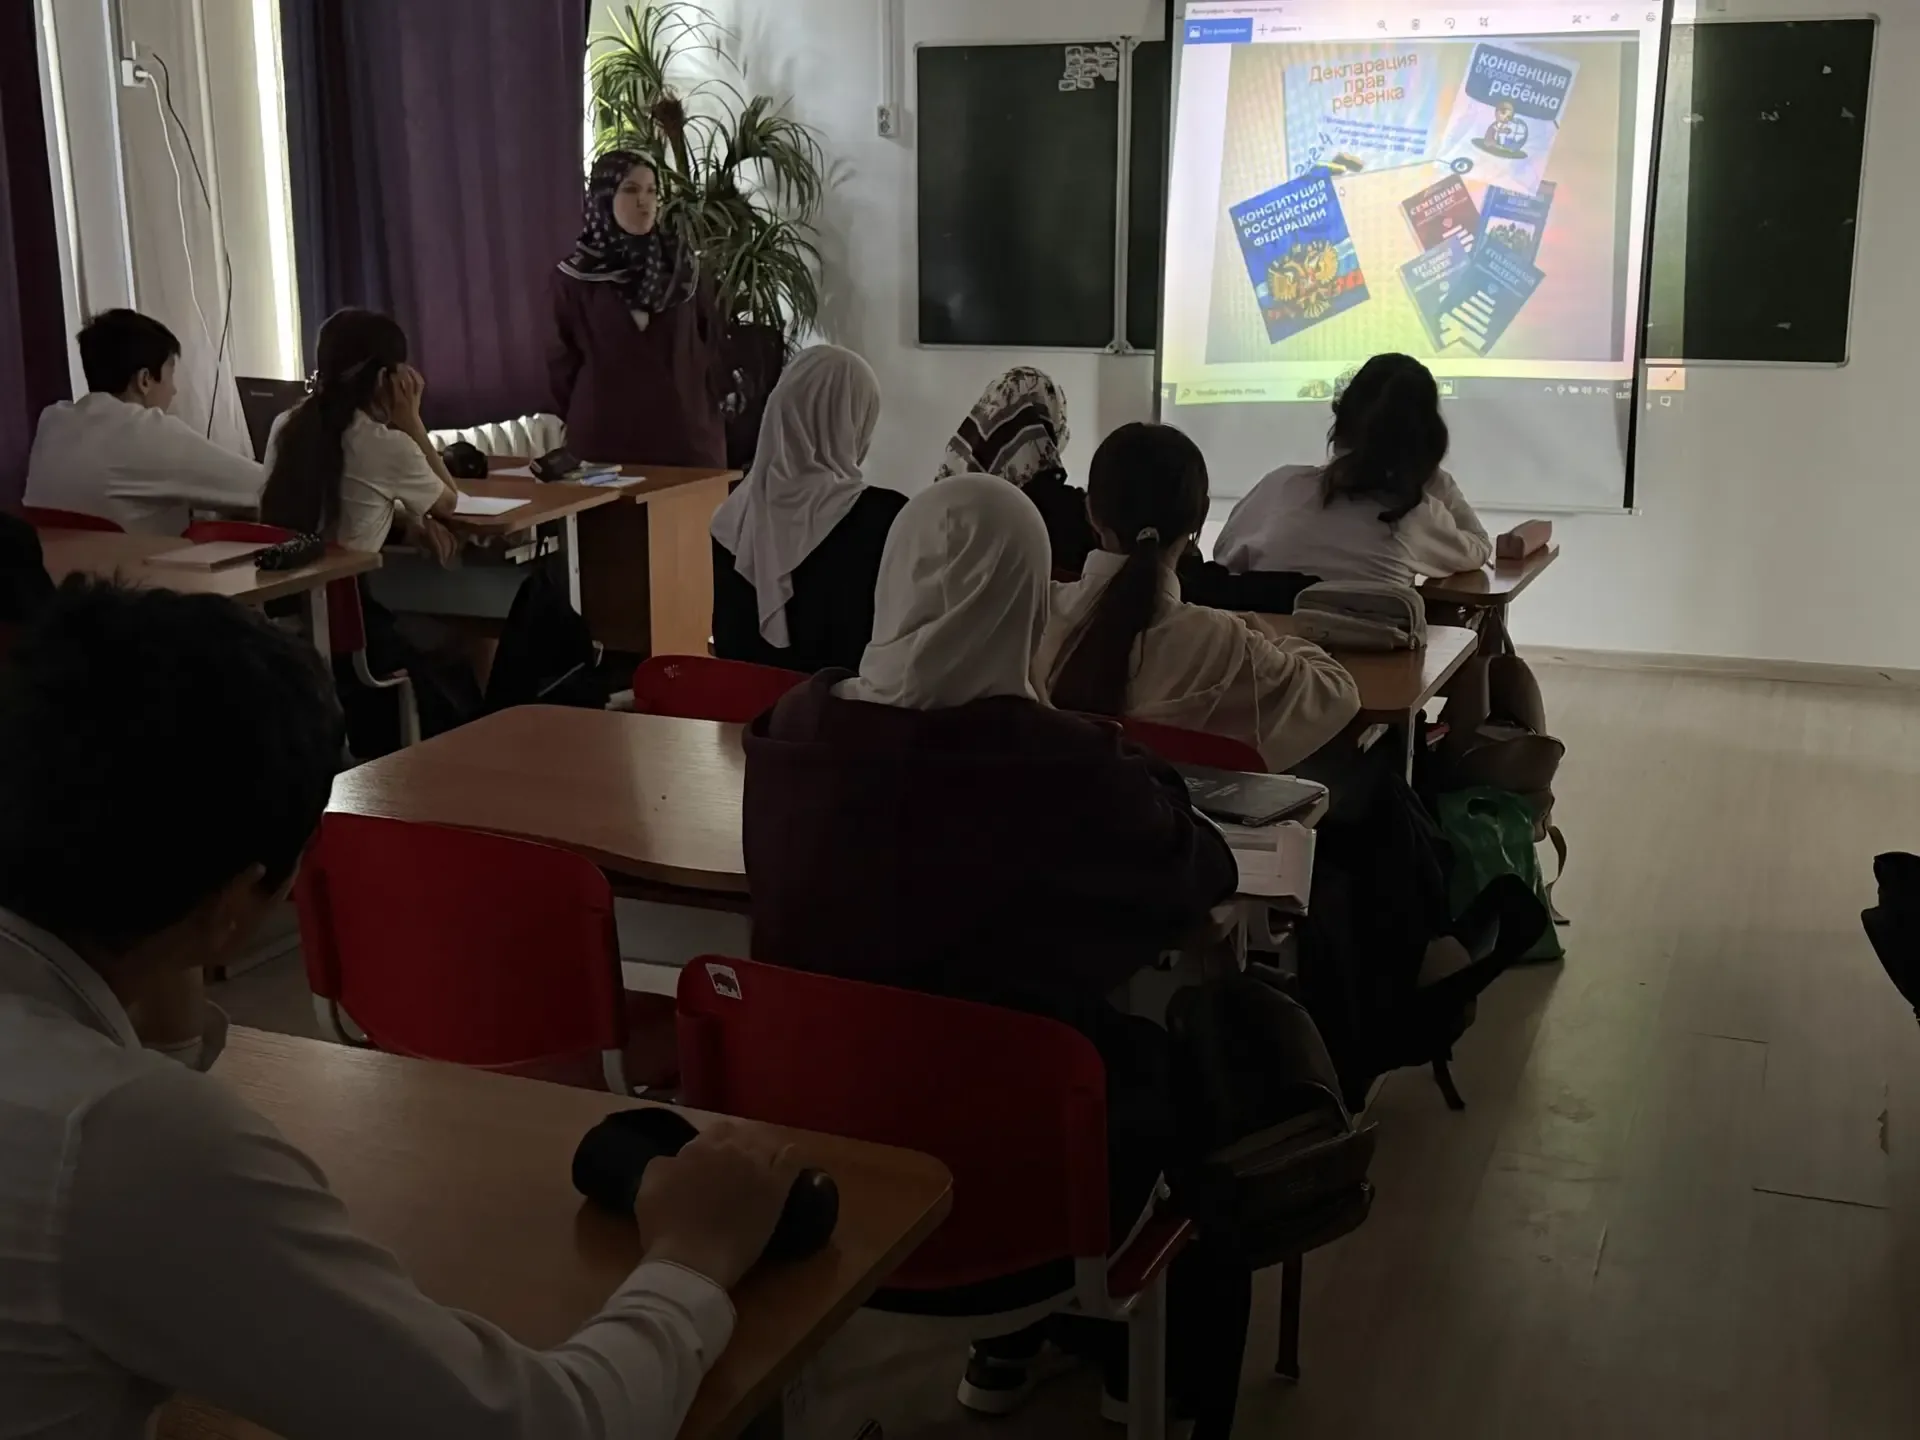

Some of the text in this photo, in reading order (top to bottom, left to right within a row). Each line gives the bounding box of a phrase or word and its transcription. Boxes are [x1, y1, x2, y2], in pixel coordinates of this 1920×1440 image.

[1309, 54, 1418, 85] Декларация
[1344, 75, 1385, 94] прав
[1238, 179, 1326, 226] КОНСТИТУЦИЯ
[1244, 192, 1328, 237] РОССИЙСКОЙ
[1253, 207, 1327, 247] ФЕДЕРАЦИИ
